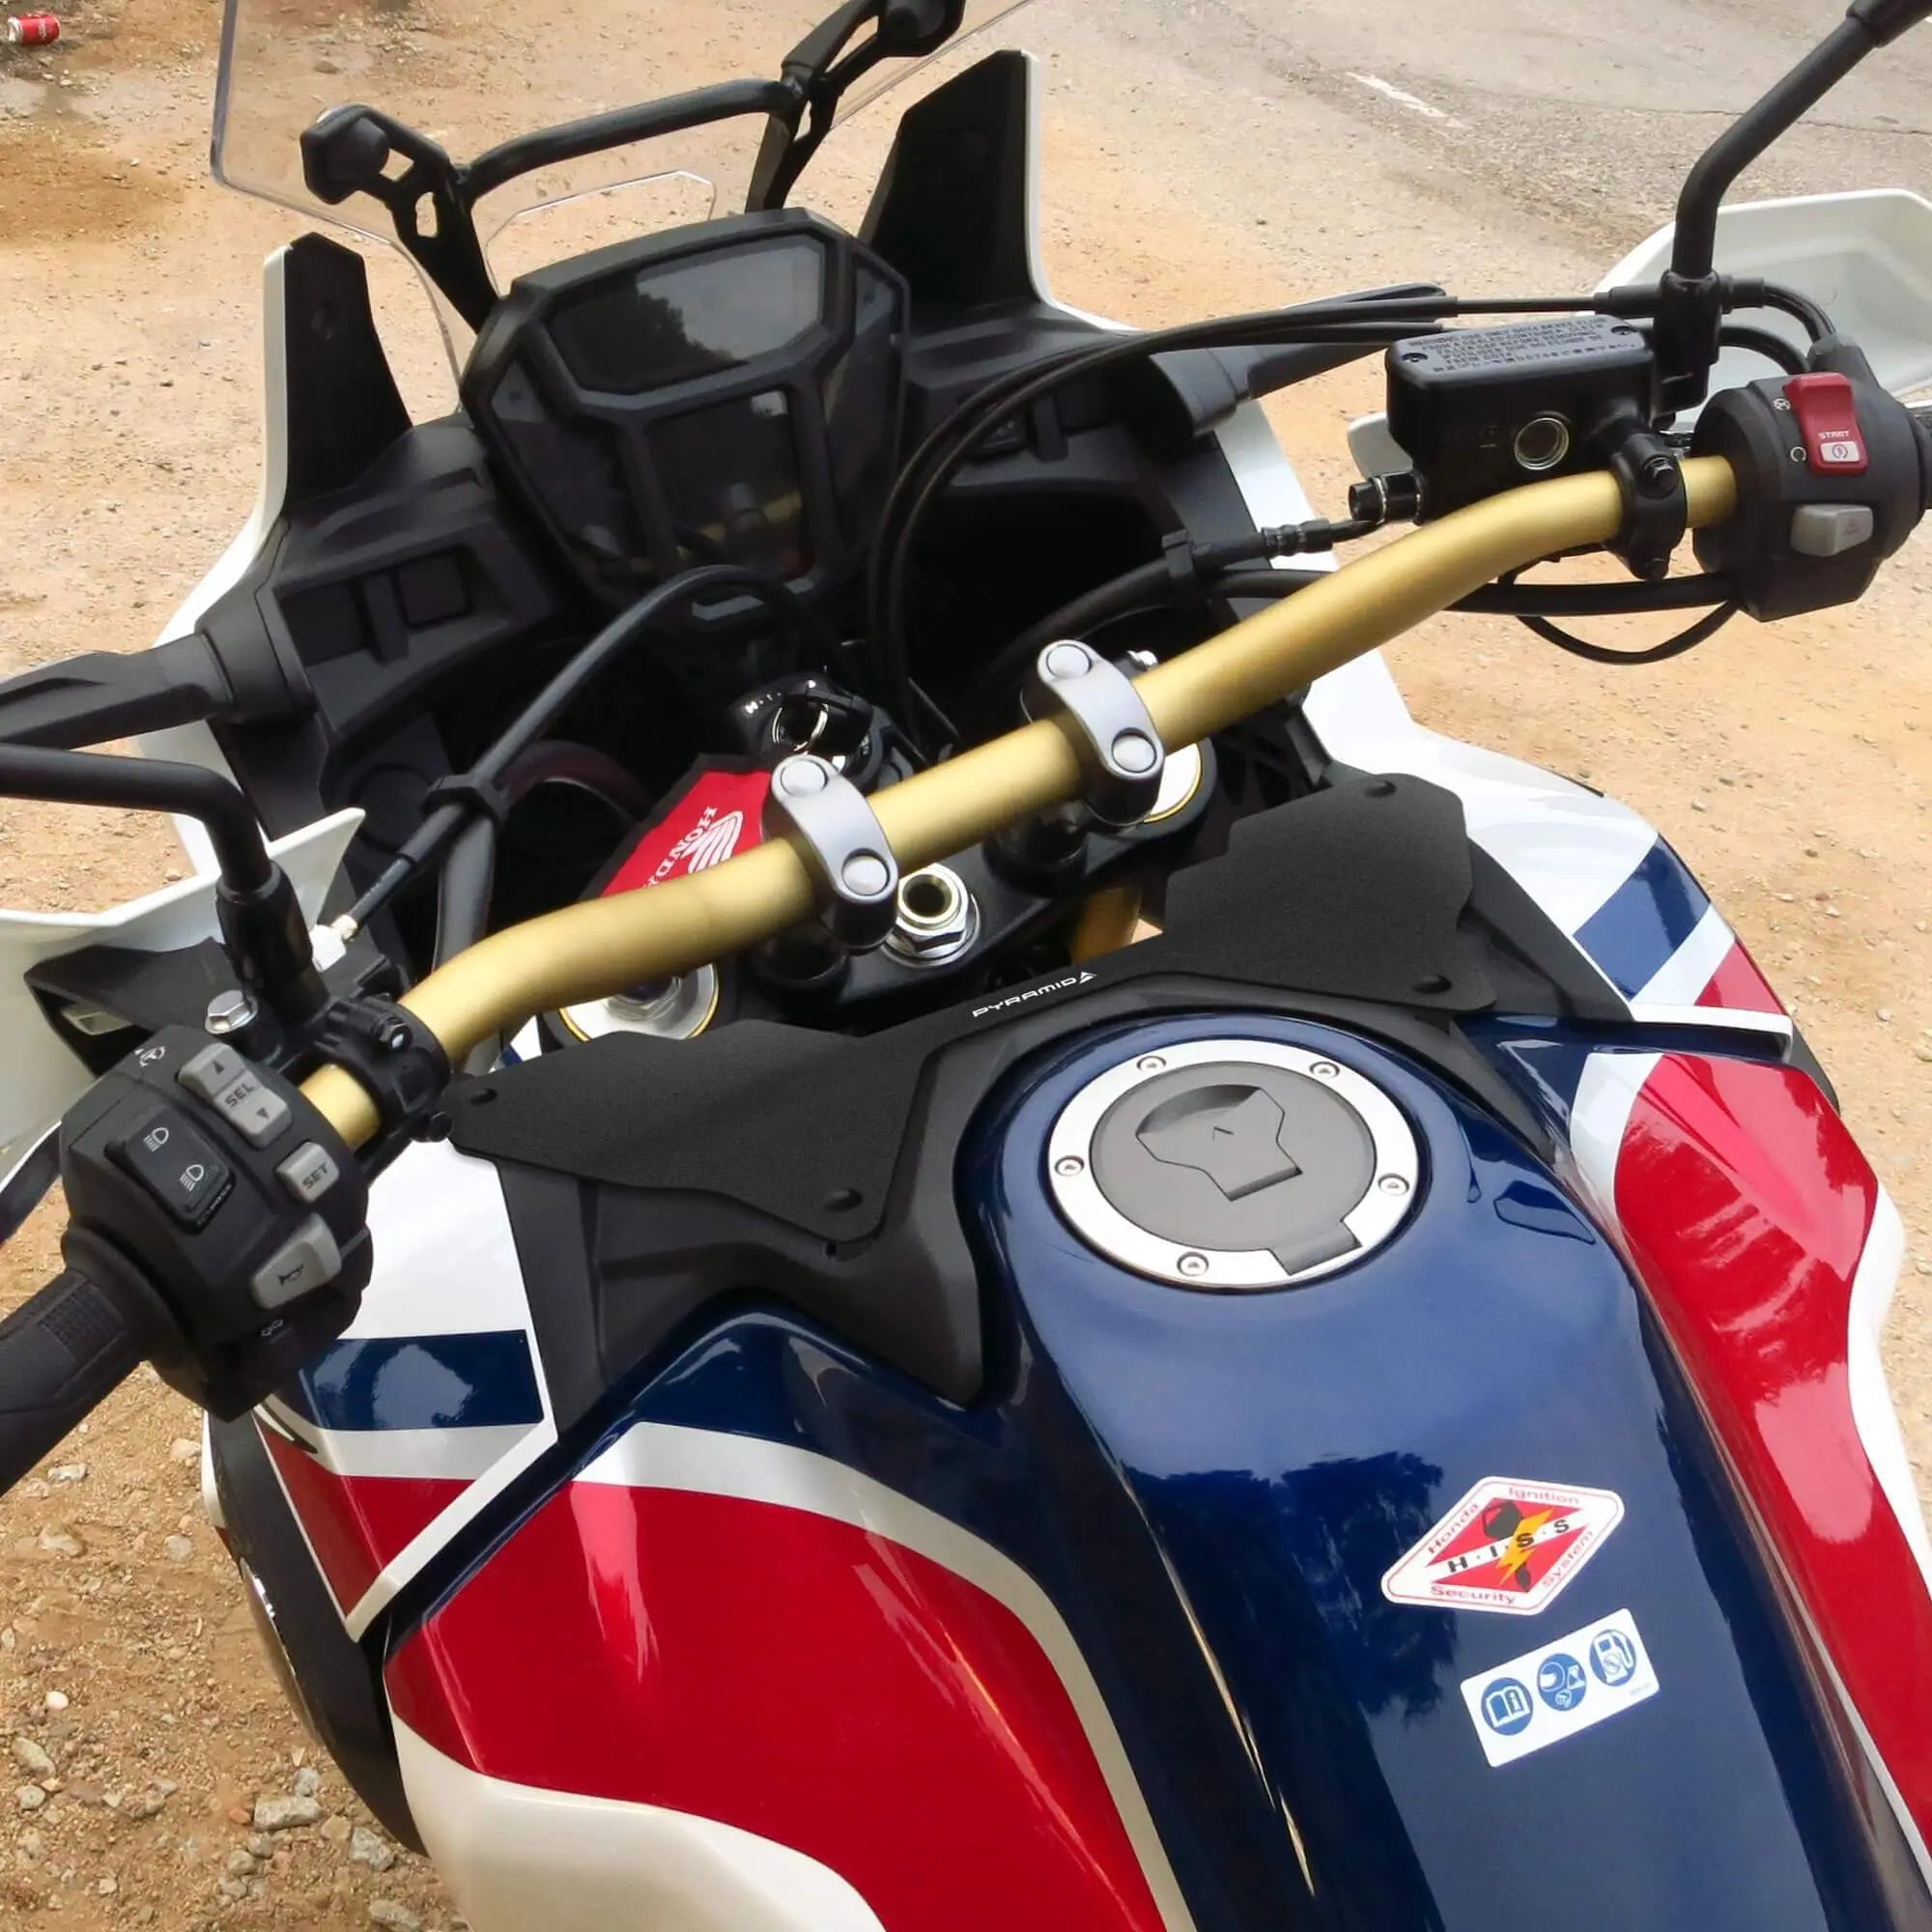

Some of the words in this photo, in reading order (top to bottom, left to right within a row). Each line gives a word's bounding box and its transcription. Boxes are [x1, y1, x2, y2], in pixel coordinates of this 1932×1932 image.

[1818, 430, 1849, 440] START
[972, 977, 1077, 1017] PYRAMID
[225, 1083, 254, 1107] SEL
[302, 1163, 327, 1189] SET
[1508, 1487, 1579, 1505] Ignition
[1428, 1503, 1479, 1553] Honda
[1542, 1529, 1594, 1586] System
[1431, 1585, 1516, 1605] Security
